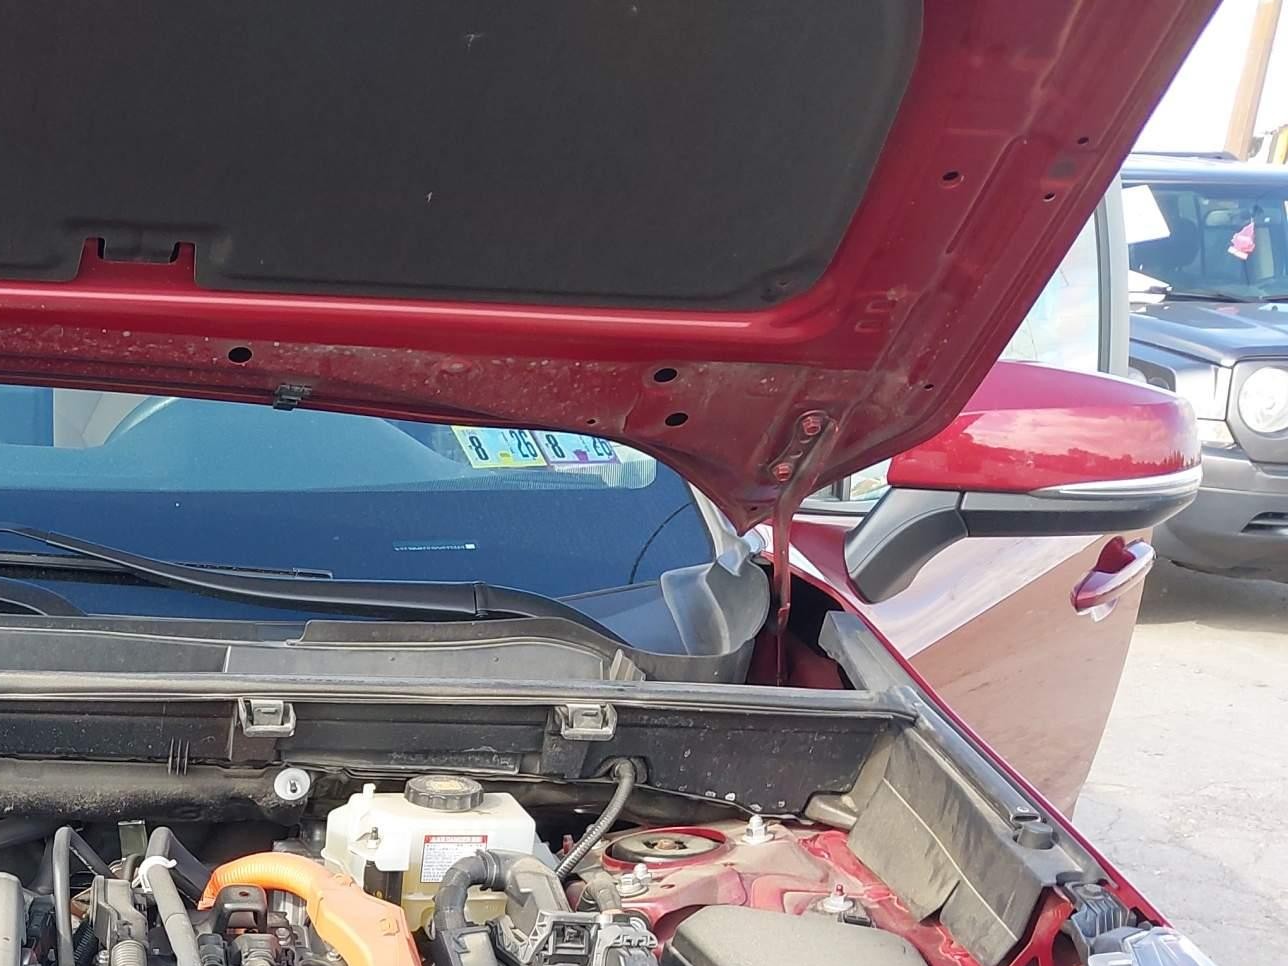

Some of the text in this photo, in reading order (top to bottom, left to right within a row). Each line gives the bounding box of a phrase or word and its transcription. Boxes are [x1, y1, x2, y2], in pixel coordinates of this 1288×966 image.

[469, 430, 538, 460] 8 26
[546, 434, 565, 458] 8
